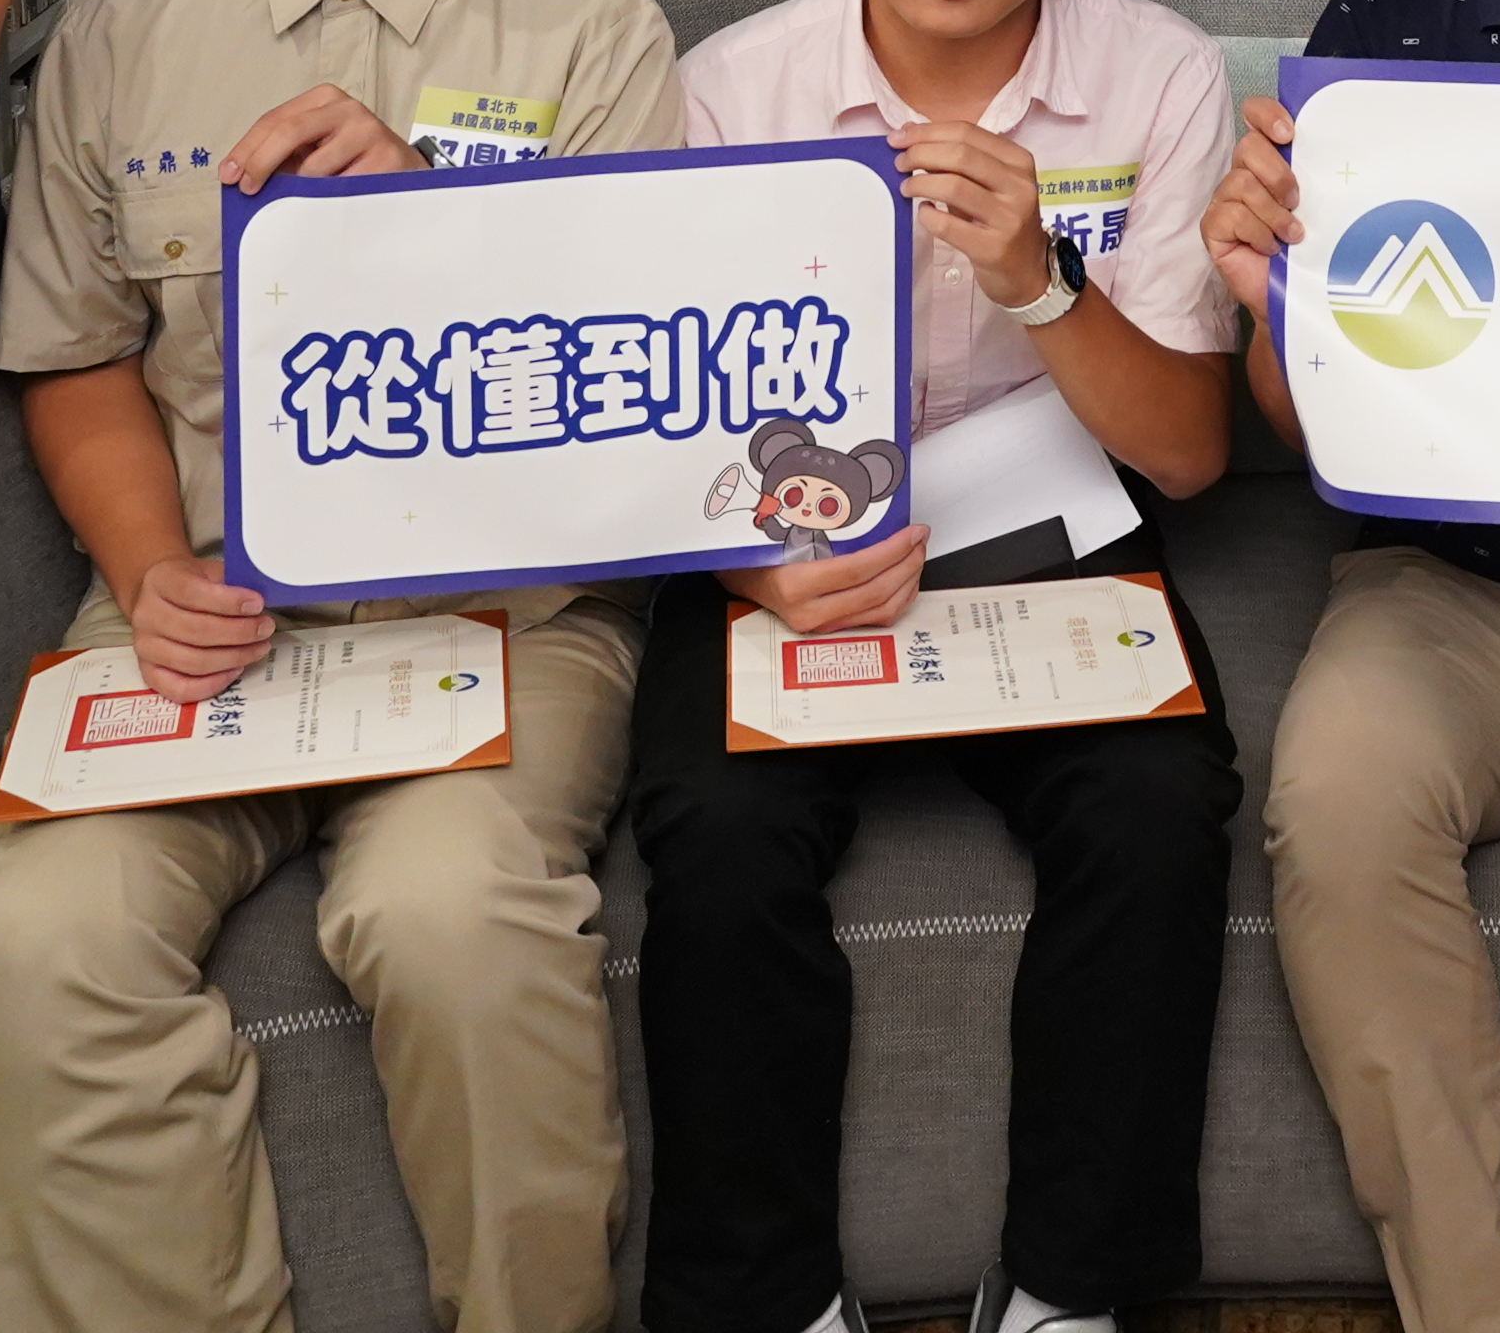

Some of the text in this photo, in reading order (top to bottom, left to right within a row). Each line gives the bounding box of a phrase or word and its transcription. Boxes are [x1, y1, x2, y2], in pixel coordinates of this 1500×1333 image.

[476, 97, 518, 116] 臺北市
[450, 112, 537, 135] 建國高級中學
[126, 146, 212, 179] 邱鼎翰
[281, 294, 850, 466] 從懂到做
